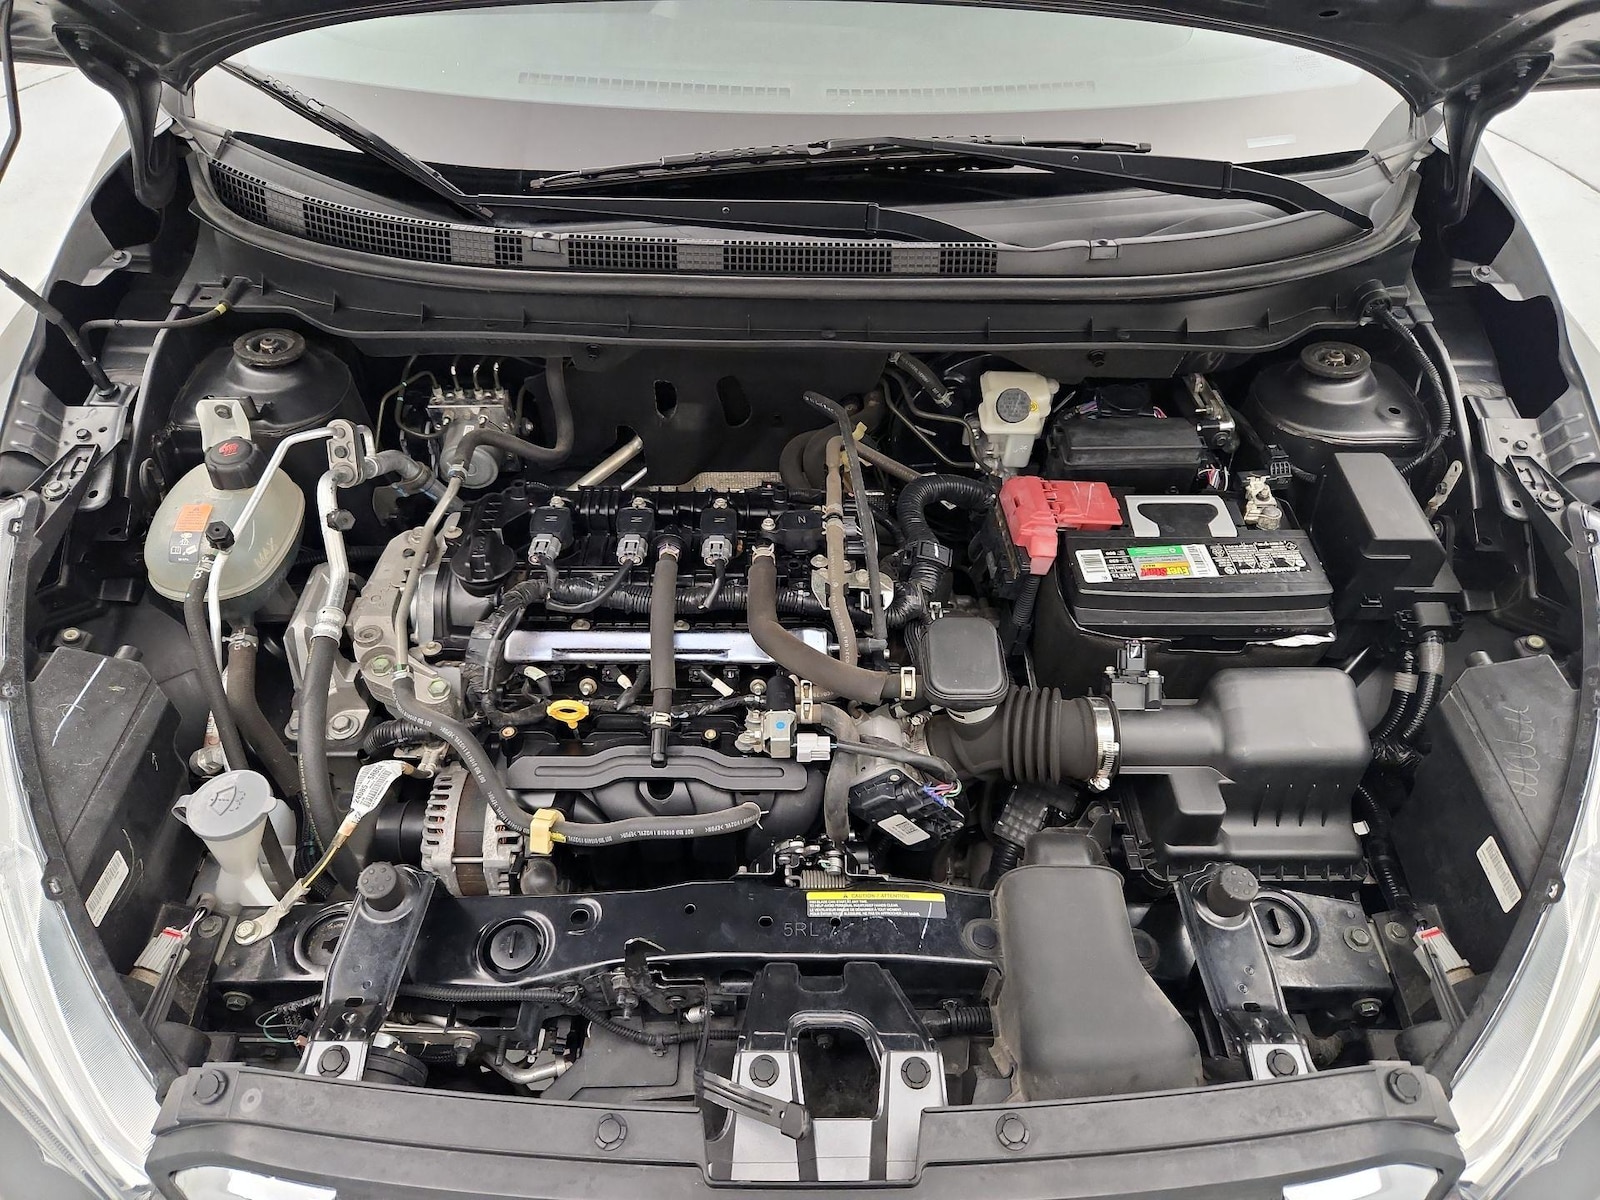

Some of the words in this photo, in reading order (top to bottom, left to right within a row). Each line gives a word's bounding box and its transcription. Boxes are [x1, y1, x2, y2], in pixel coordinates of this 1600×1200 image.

[797, 515, 806, 524] N
[1140, 565, 1190, 578] EverStart
[783, 922, 819, 937] 5RL
